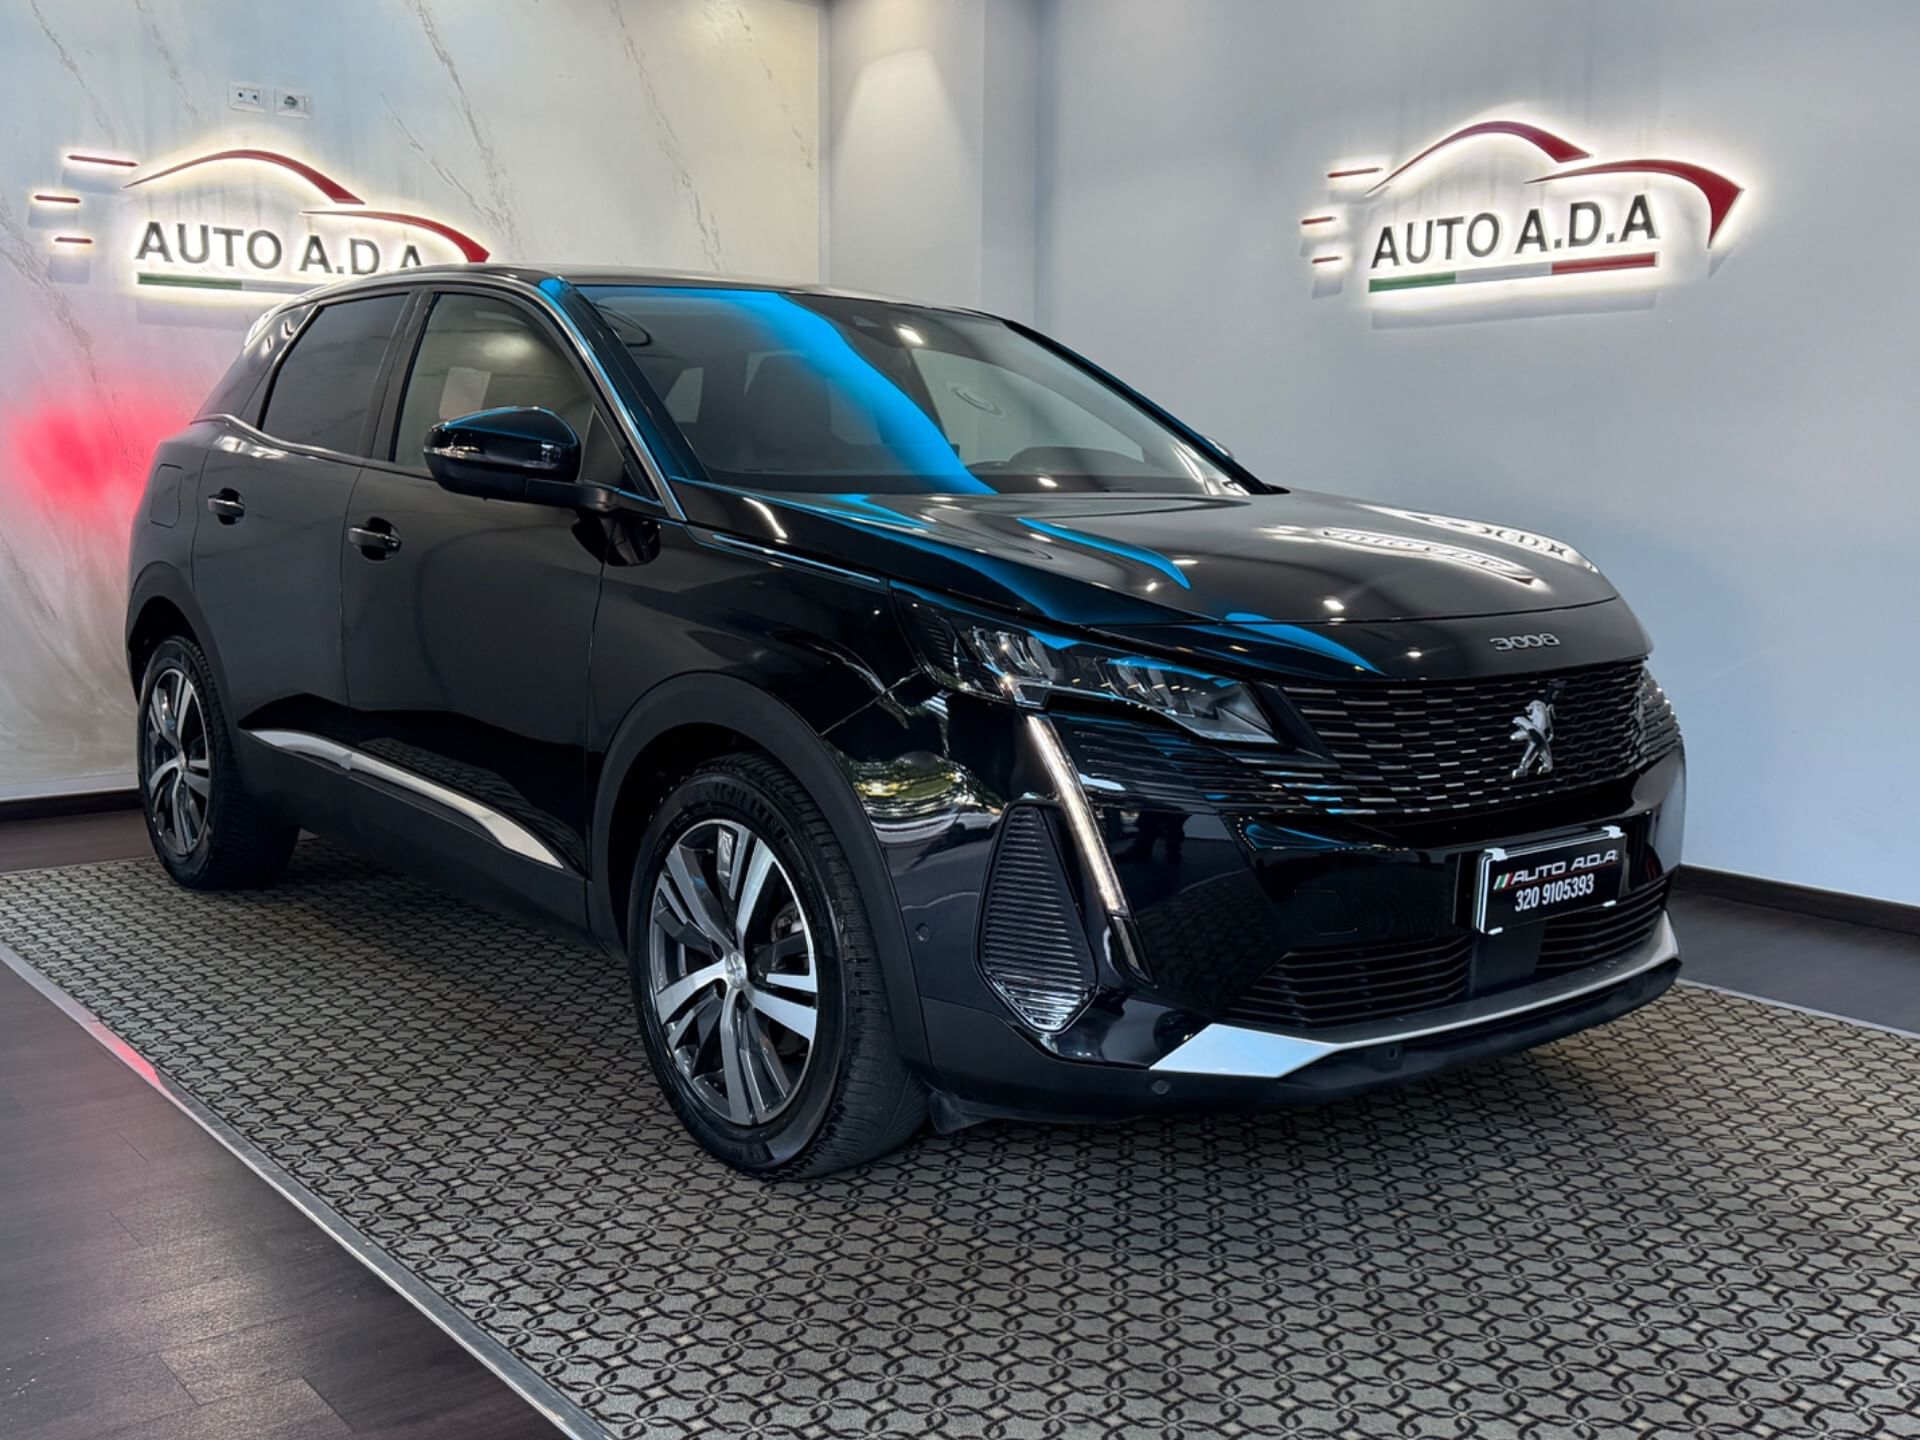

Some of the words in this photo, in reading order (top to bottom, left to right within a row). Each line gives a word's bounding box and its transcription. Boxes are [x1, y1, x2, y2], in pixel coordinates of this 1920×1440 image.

[135, 221, 282, 270] AUTO
[299, 235, 422, 275] A.DA
[1371, 213, 1501, 268] AUTO
[1514, 194, 1657, 254] A.D.A
[1489, 632, 1561, 651] 3008
[1511, 861, 1566, 884] AUTO
[1514, 886, 1540, 912] 320
[1542, 874, 1594, 905] 9105393
